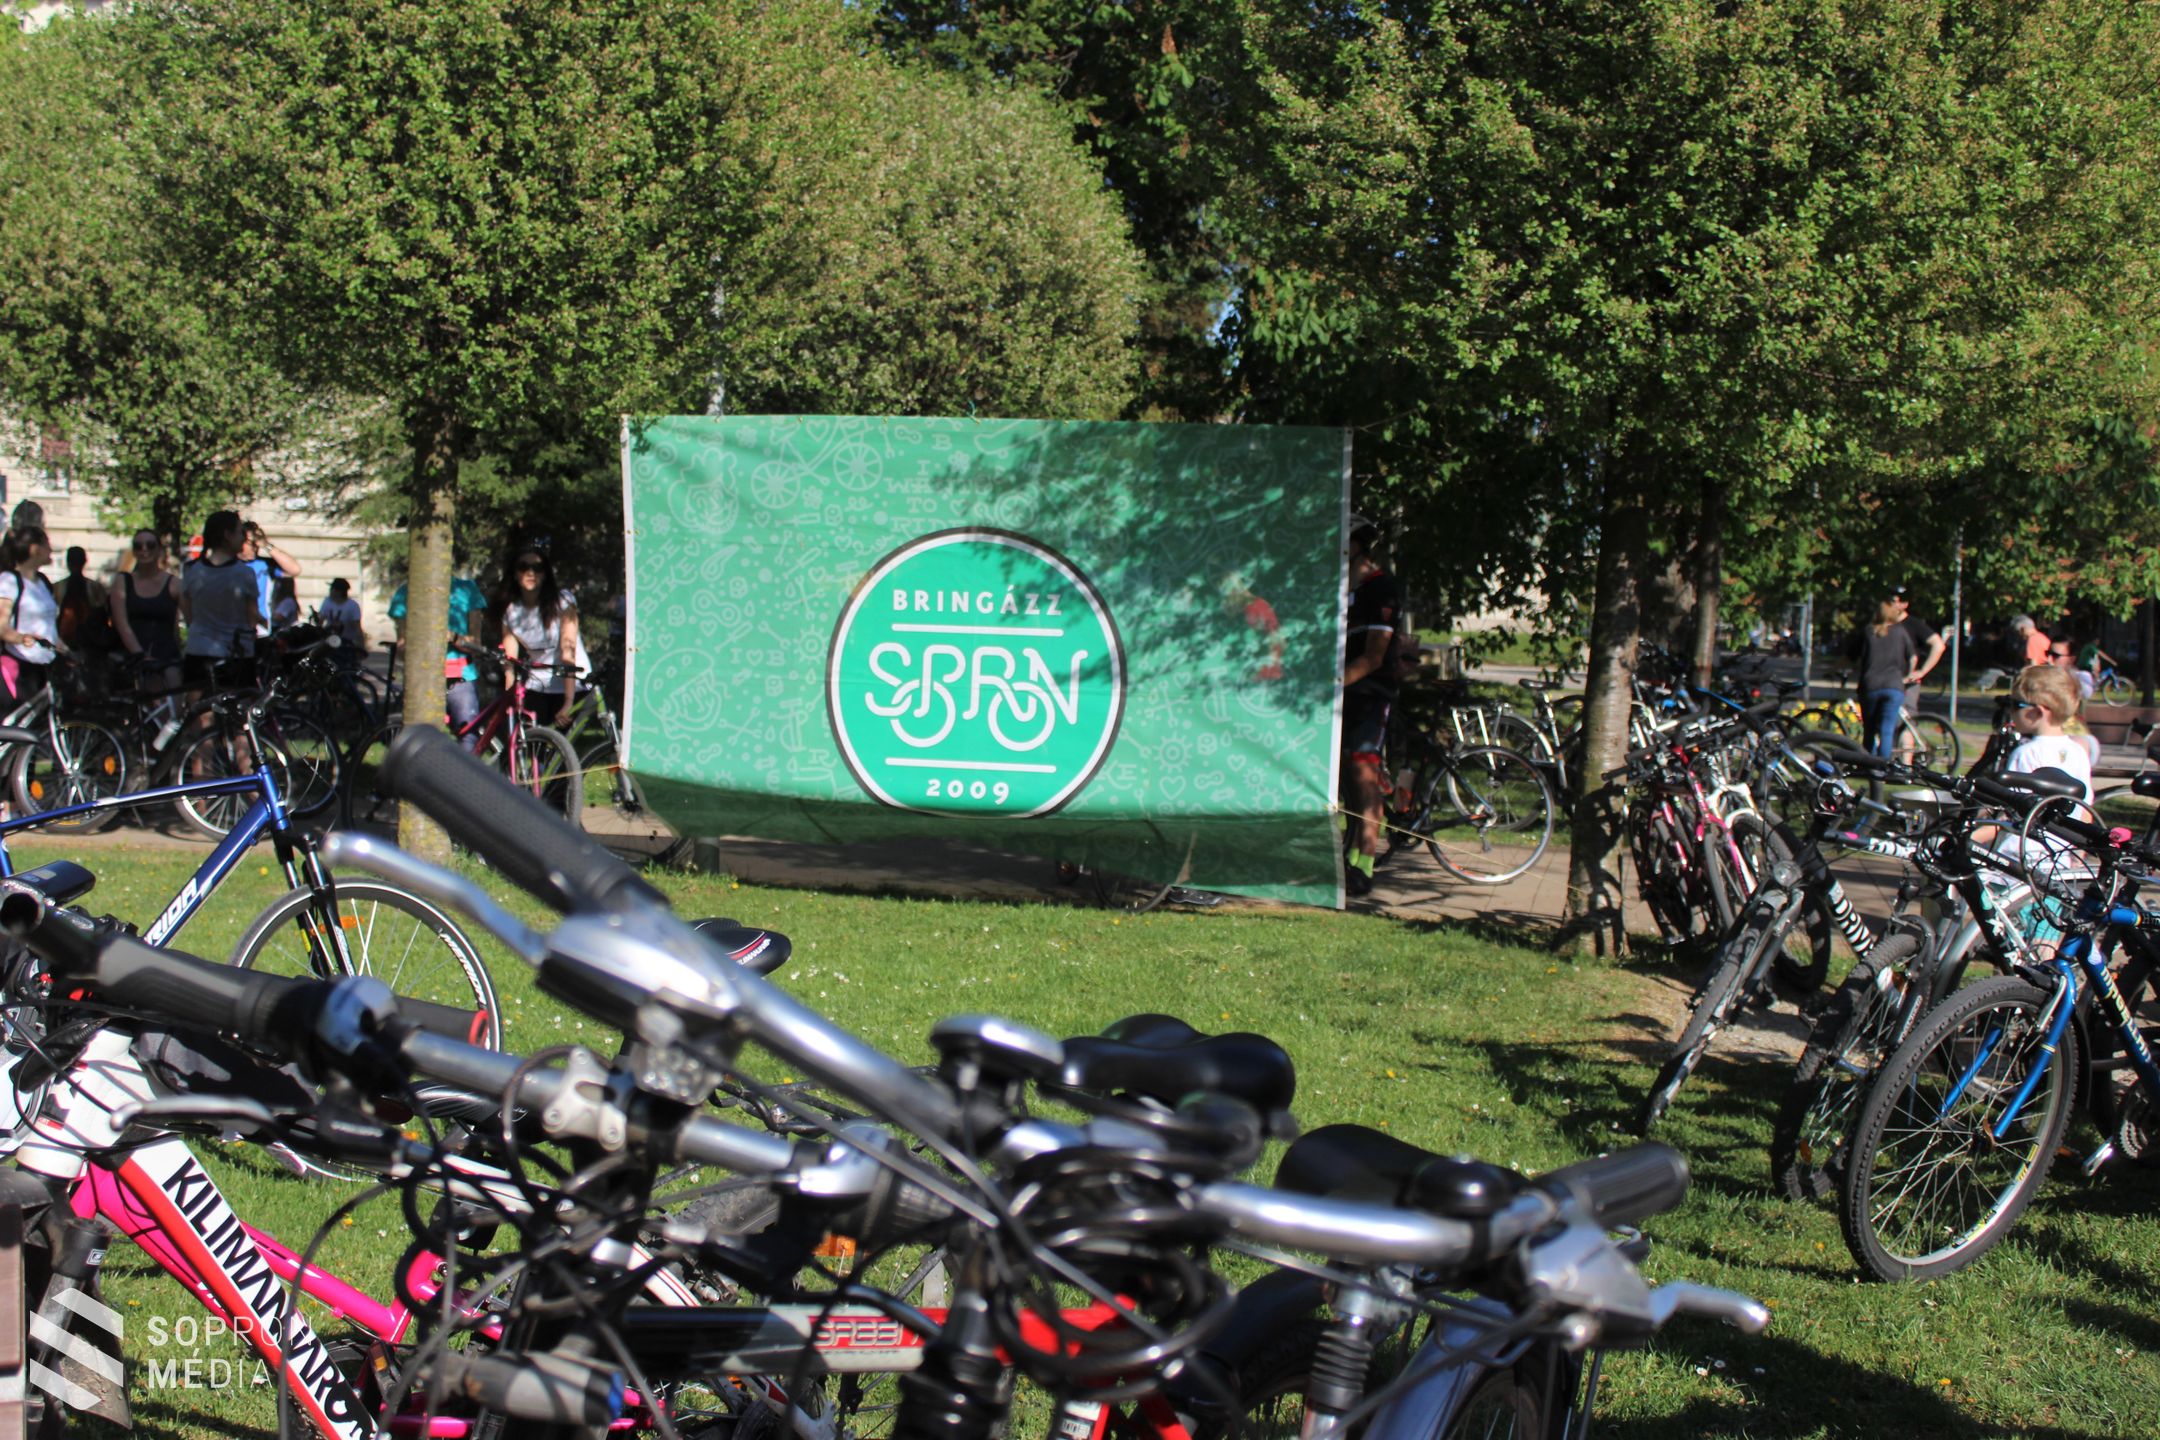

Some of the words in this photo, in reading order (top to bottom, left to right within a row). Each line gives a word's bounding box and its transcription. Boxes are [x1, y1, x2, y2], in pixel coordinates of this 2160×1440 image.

[907, 497, 937, 513] TO
[637, 556, 697, 619] BIKE
[892, 585, 1064, 616] BRINGÁZZ
[926, 778, 1011, 805] 2009
[143, 877, 199, 947] RIDA
